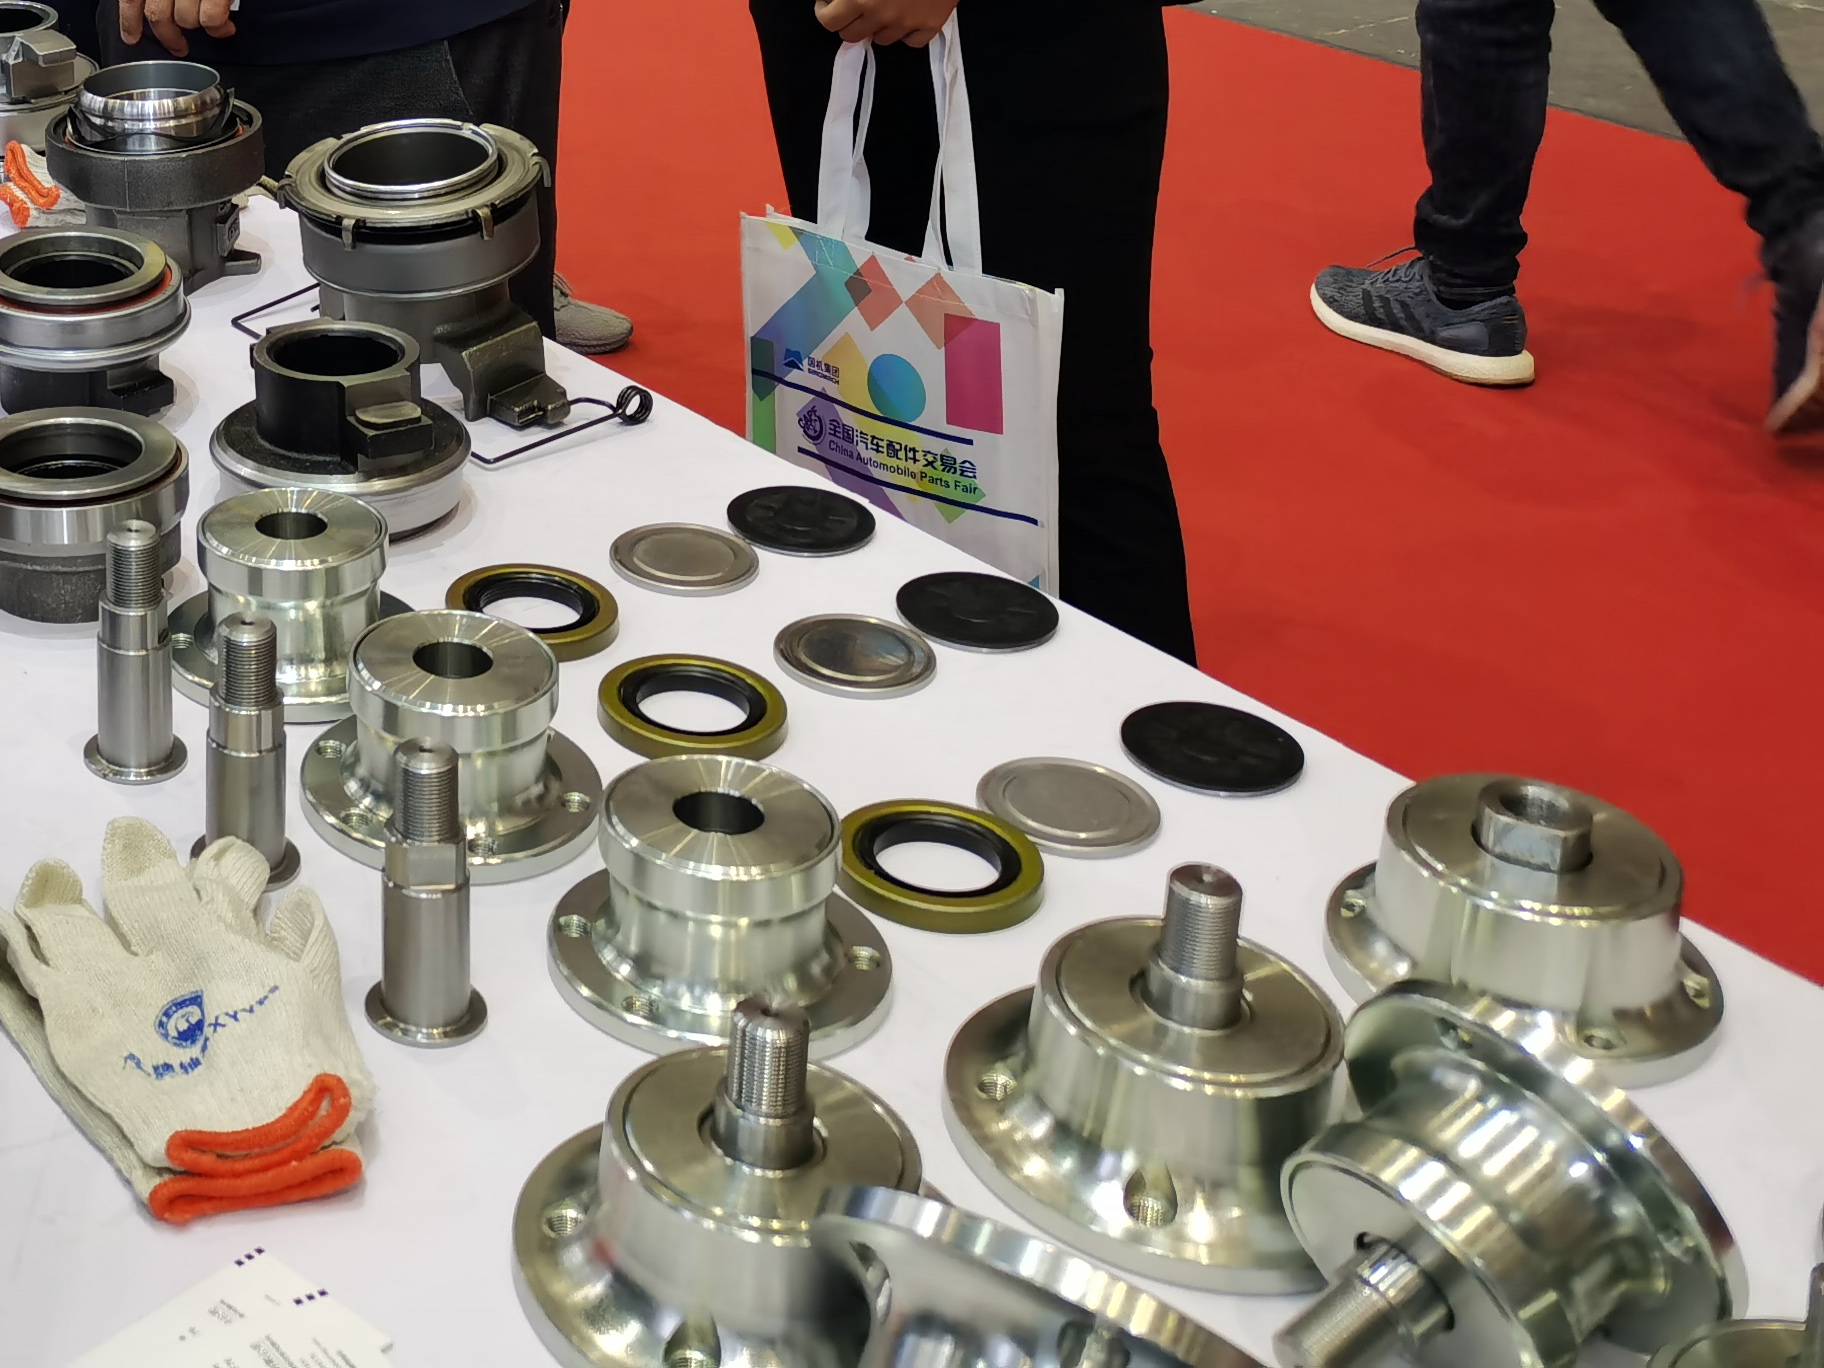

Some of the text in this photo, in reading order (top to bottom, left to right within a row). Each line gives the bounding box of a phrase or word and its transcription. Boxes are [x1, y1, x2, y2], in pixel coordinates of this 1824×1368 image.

[807, 356, 840, 378] 国机集团
[828, 418, 977, 480] 全国汽车配件交易会
[828, 439, 978, 495] China Automobile Parts Fair
